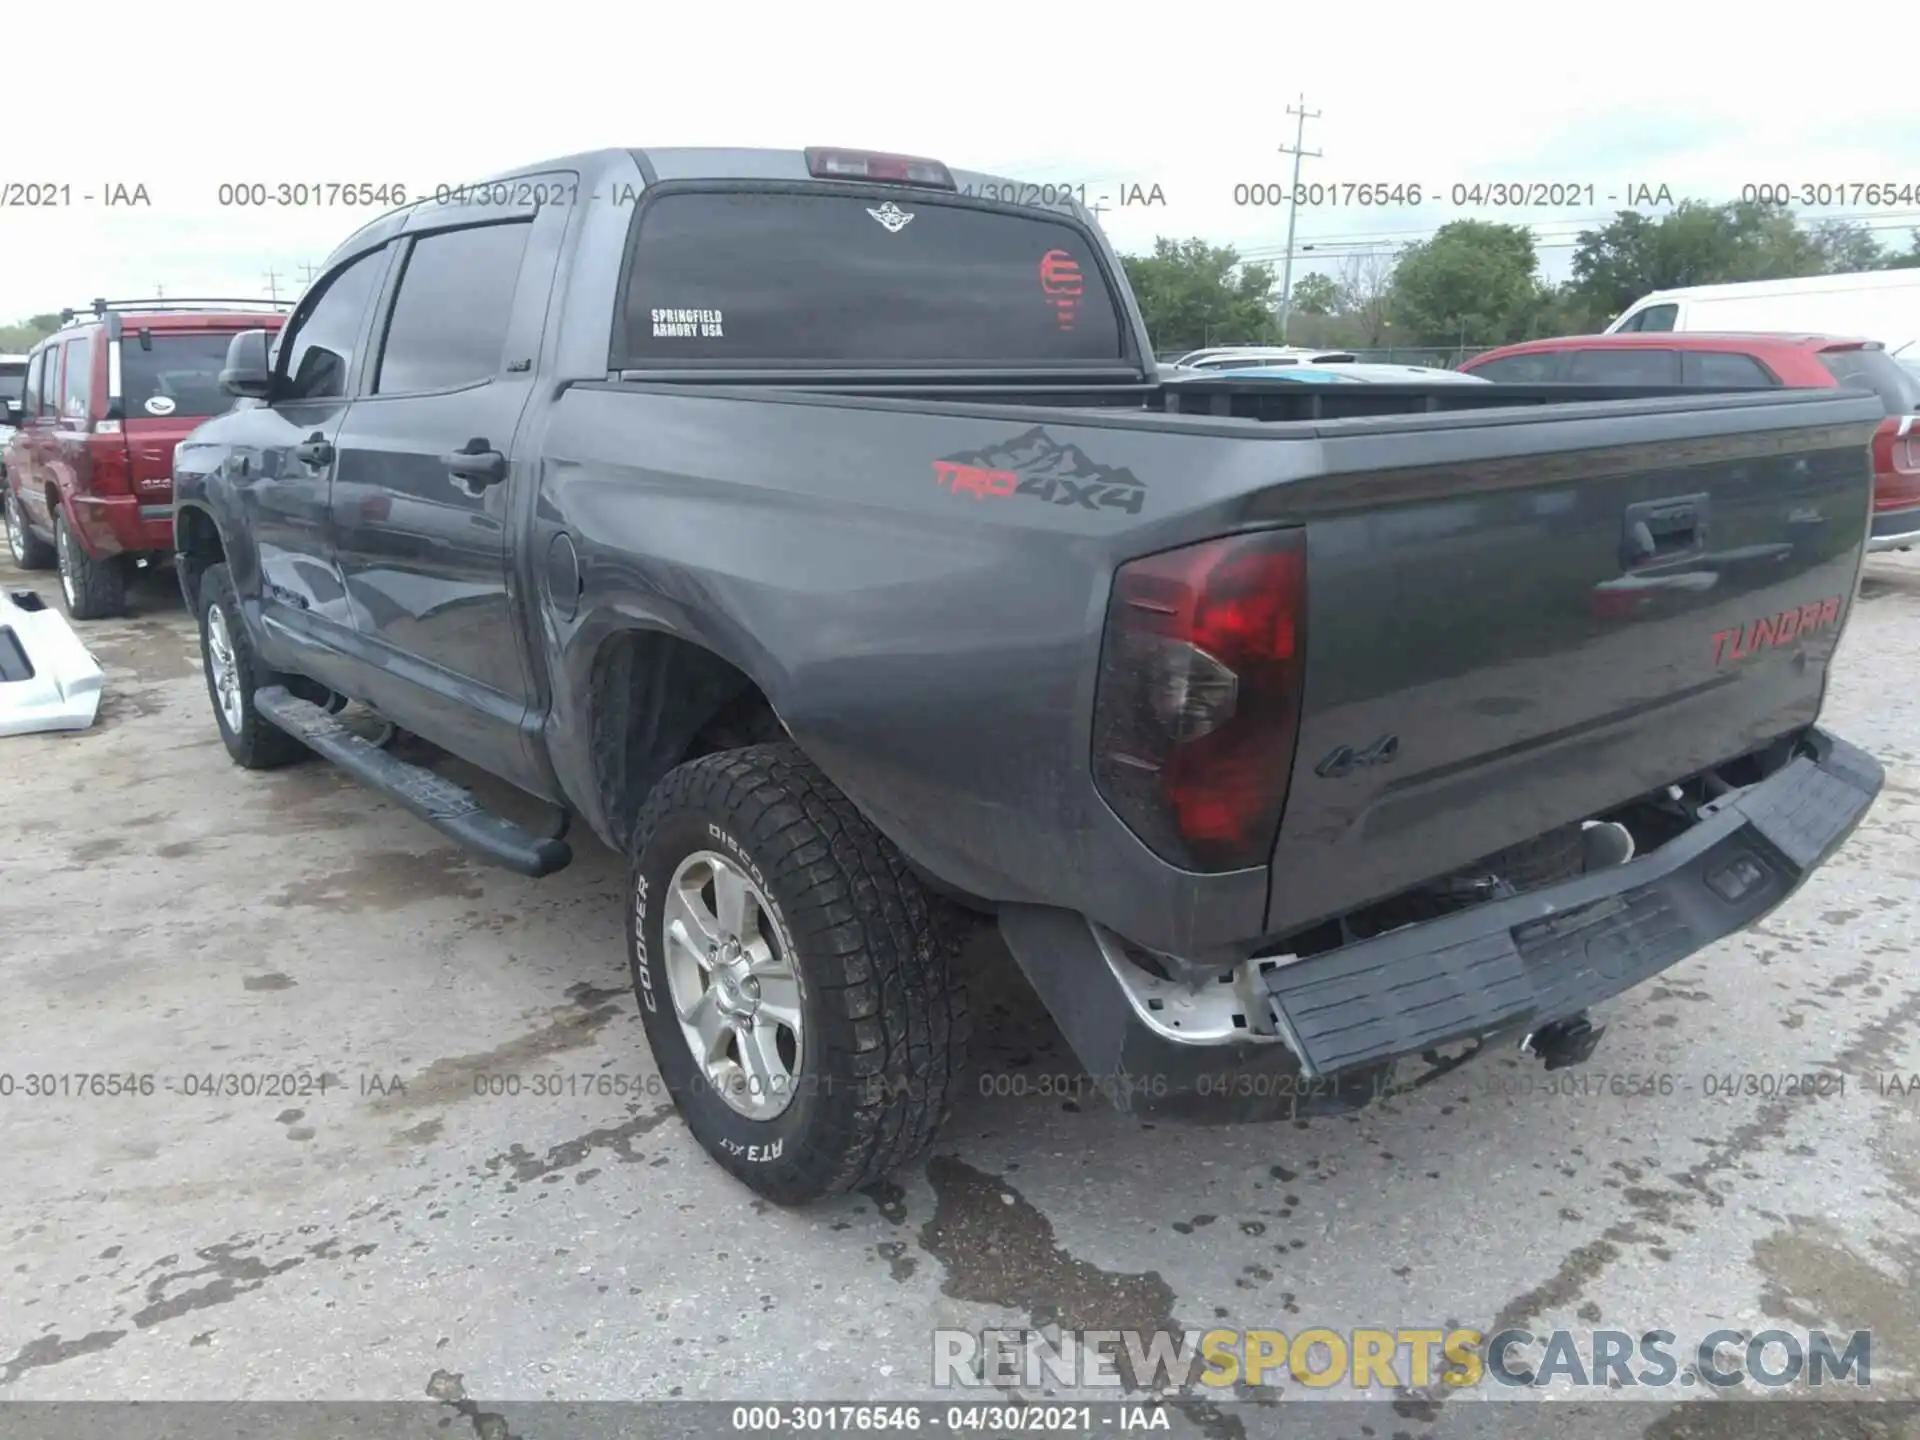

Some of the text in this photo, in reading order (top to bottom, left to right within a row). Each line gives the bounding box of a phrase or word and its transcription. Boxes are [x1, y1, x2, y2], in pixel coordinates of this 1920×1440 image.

[651, 309, 723, 323] SPRINGFIELD
[652, 323, 724, 337] ARMORY USA
[1711, 594, 1843, 668] TUNDRA
[635, 873, 657, 1013] COOPER
[747, 1137, 783, 1162] AT3
